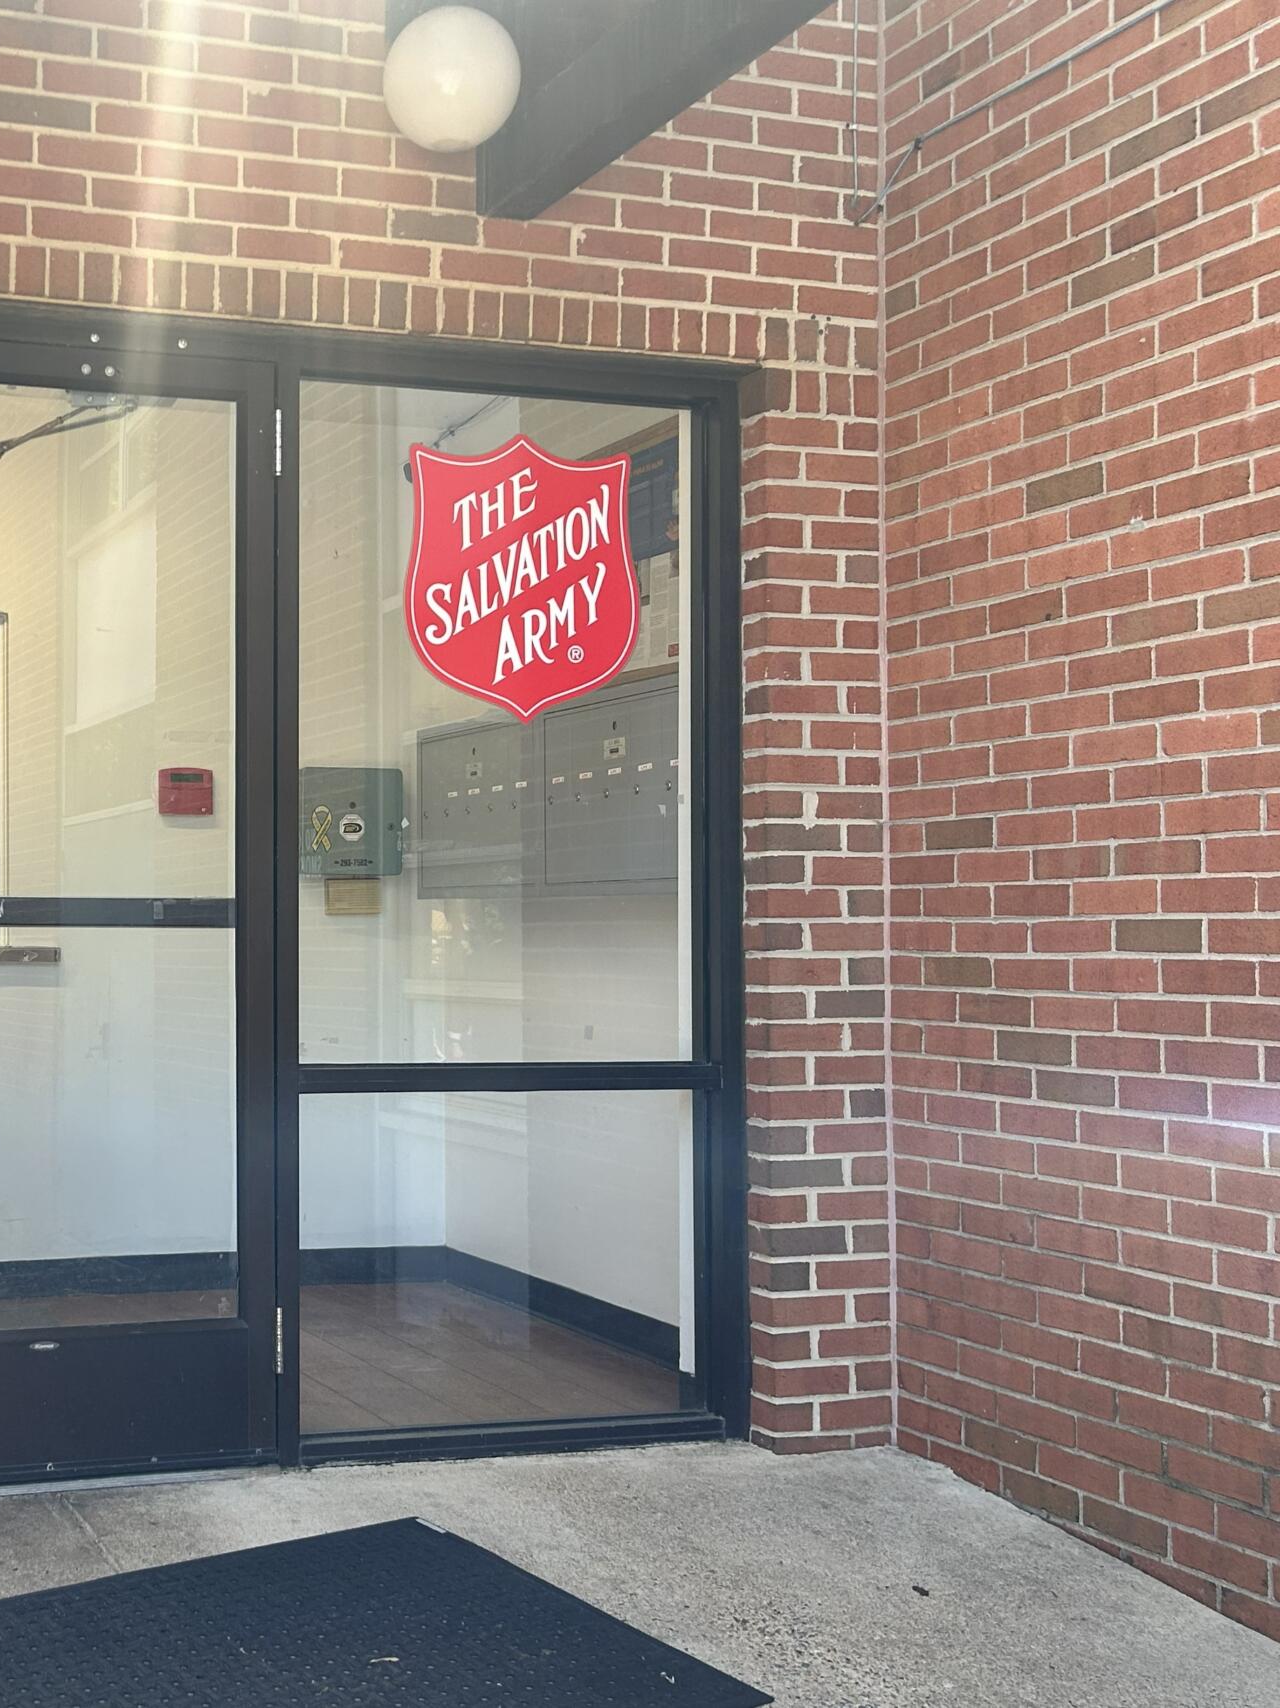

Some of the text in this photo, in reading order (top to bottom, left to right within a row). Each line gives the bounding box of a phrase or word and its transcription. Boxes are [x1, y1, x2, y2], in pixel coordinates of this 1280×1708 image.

[424, 483, 611, 646] SALVATION
[452, 466, 539, 551] THE
[492, 562, 608, 686] ARMY
